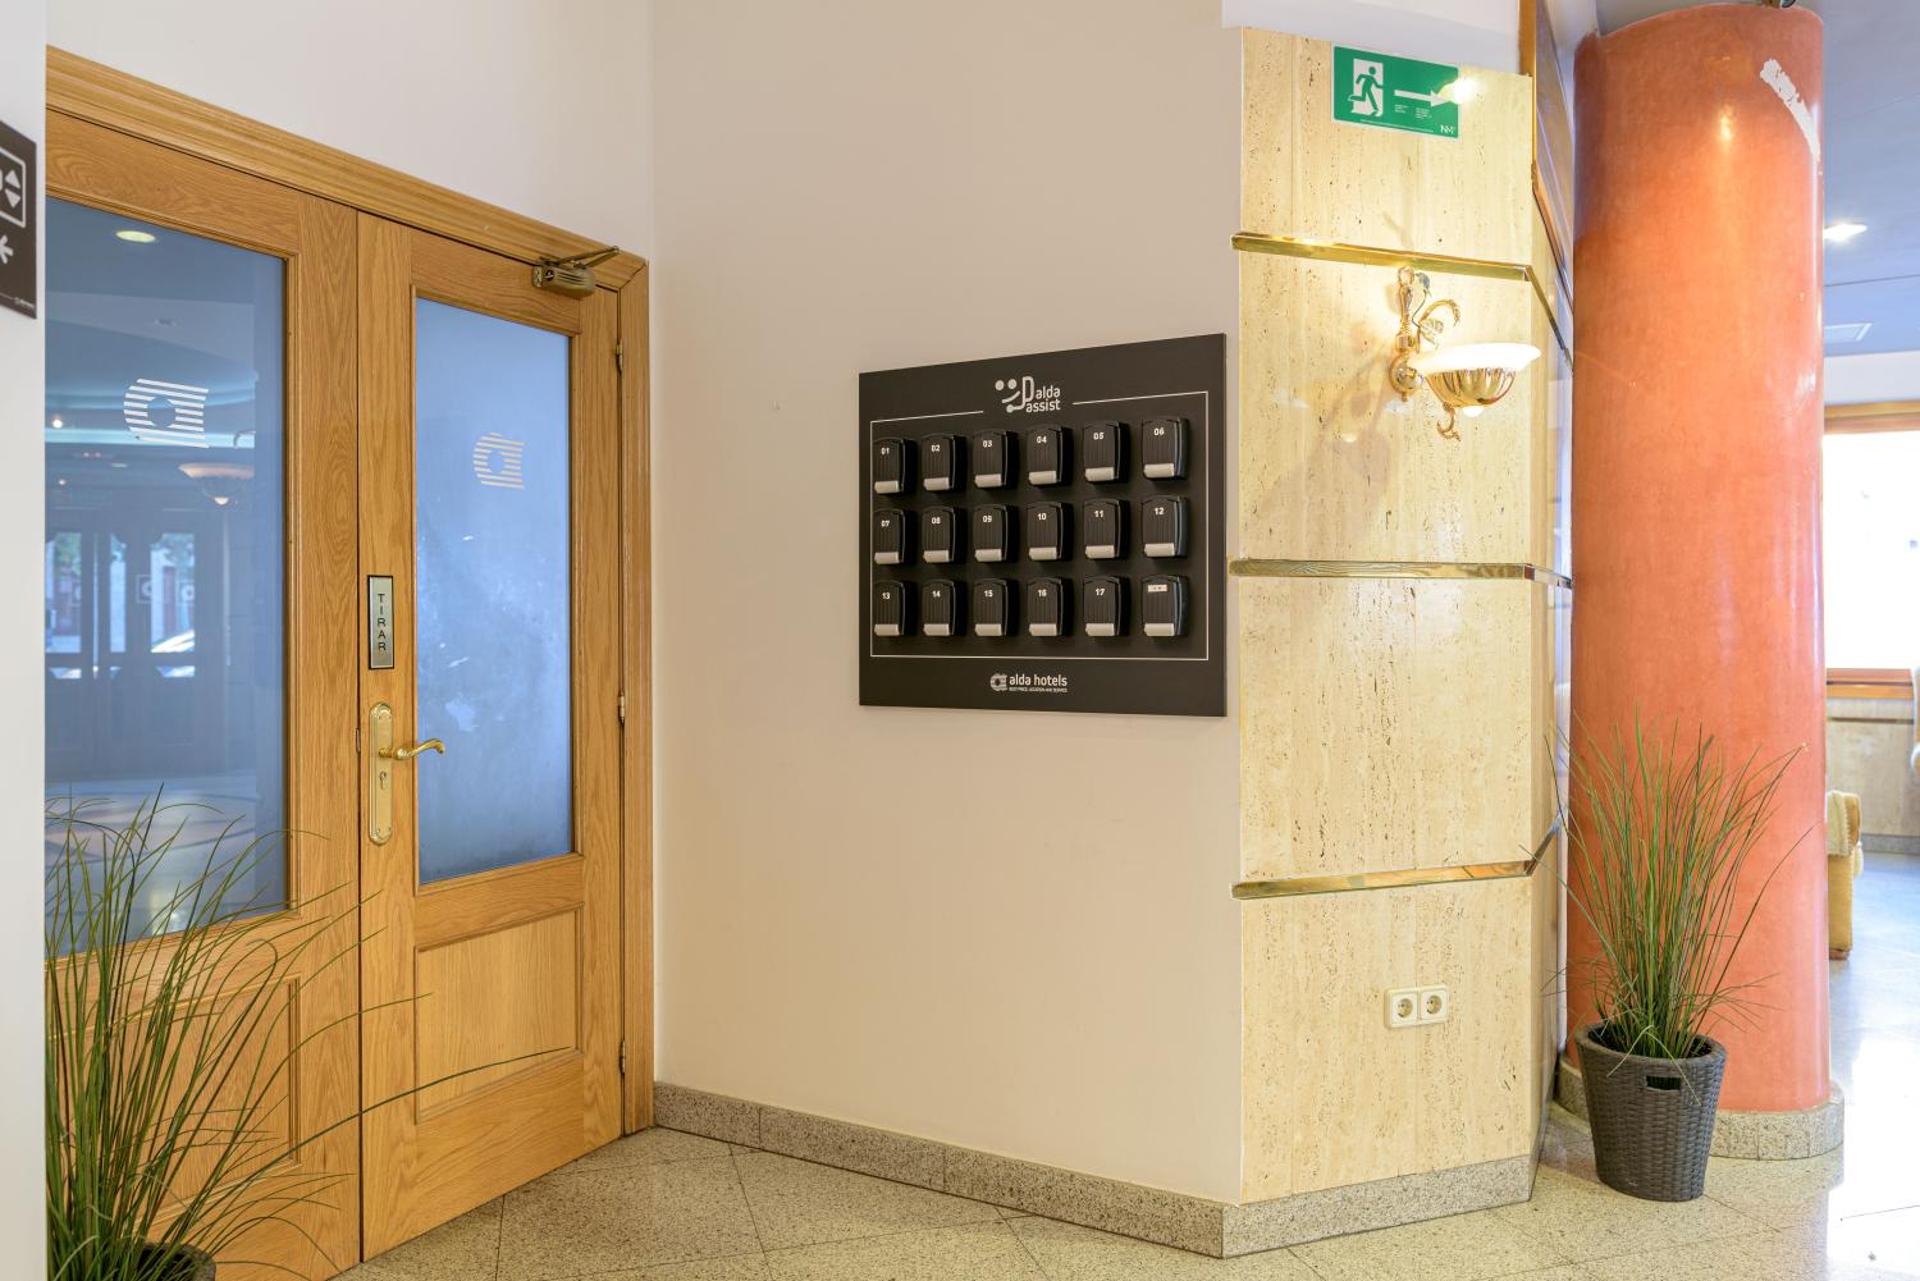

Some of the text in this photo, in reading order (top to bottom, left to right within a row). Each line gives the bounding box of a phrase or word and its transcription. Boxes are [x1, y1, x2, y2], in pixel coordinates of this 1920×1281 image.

[1035, 385, 1061, 400] alda
[1026, 398, 1061, 413] assist
[1093, 431, 1105, 441] 05
[1153, 427, 1165, 436] 06
[982, 439, 993, 448] 03
[1036, 435, 1047, 444] 04
[881, 447, 890, 455] 01
[931, 444, 941, 453] 02
[1094, 509, 1104, 518] 11
[1154, 506, 1165, 516] 12
[931, 516, 941, 525] 08
[982, 515, 993, 523] 09
[1037, 512, 1047, 521] 10
[881, 519, 891, 527] 07
[882, 591, 891, 600] 13
[932, 590, 941, 598] 14
[984, 589, 993, 598] 15
[1037, 588, 1047, 597] 16
[1095, 588, 1106, 596] 17
[377, 593, 386, 651] TIRAR
[1010, 674, 1067, 686] alda hotels
